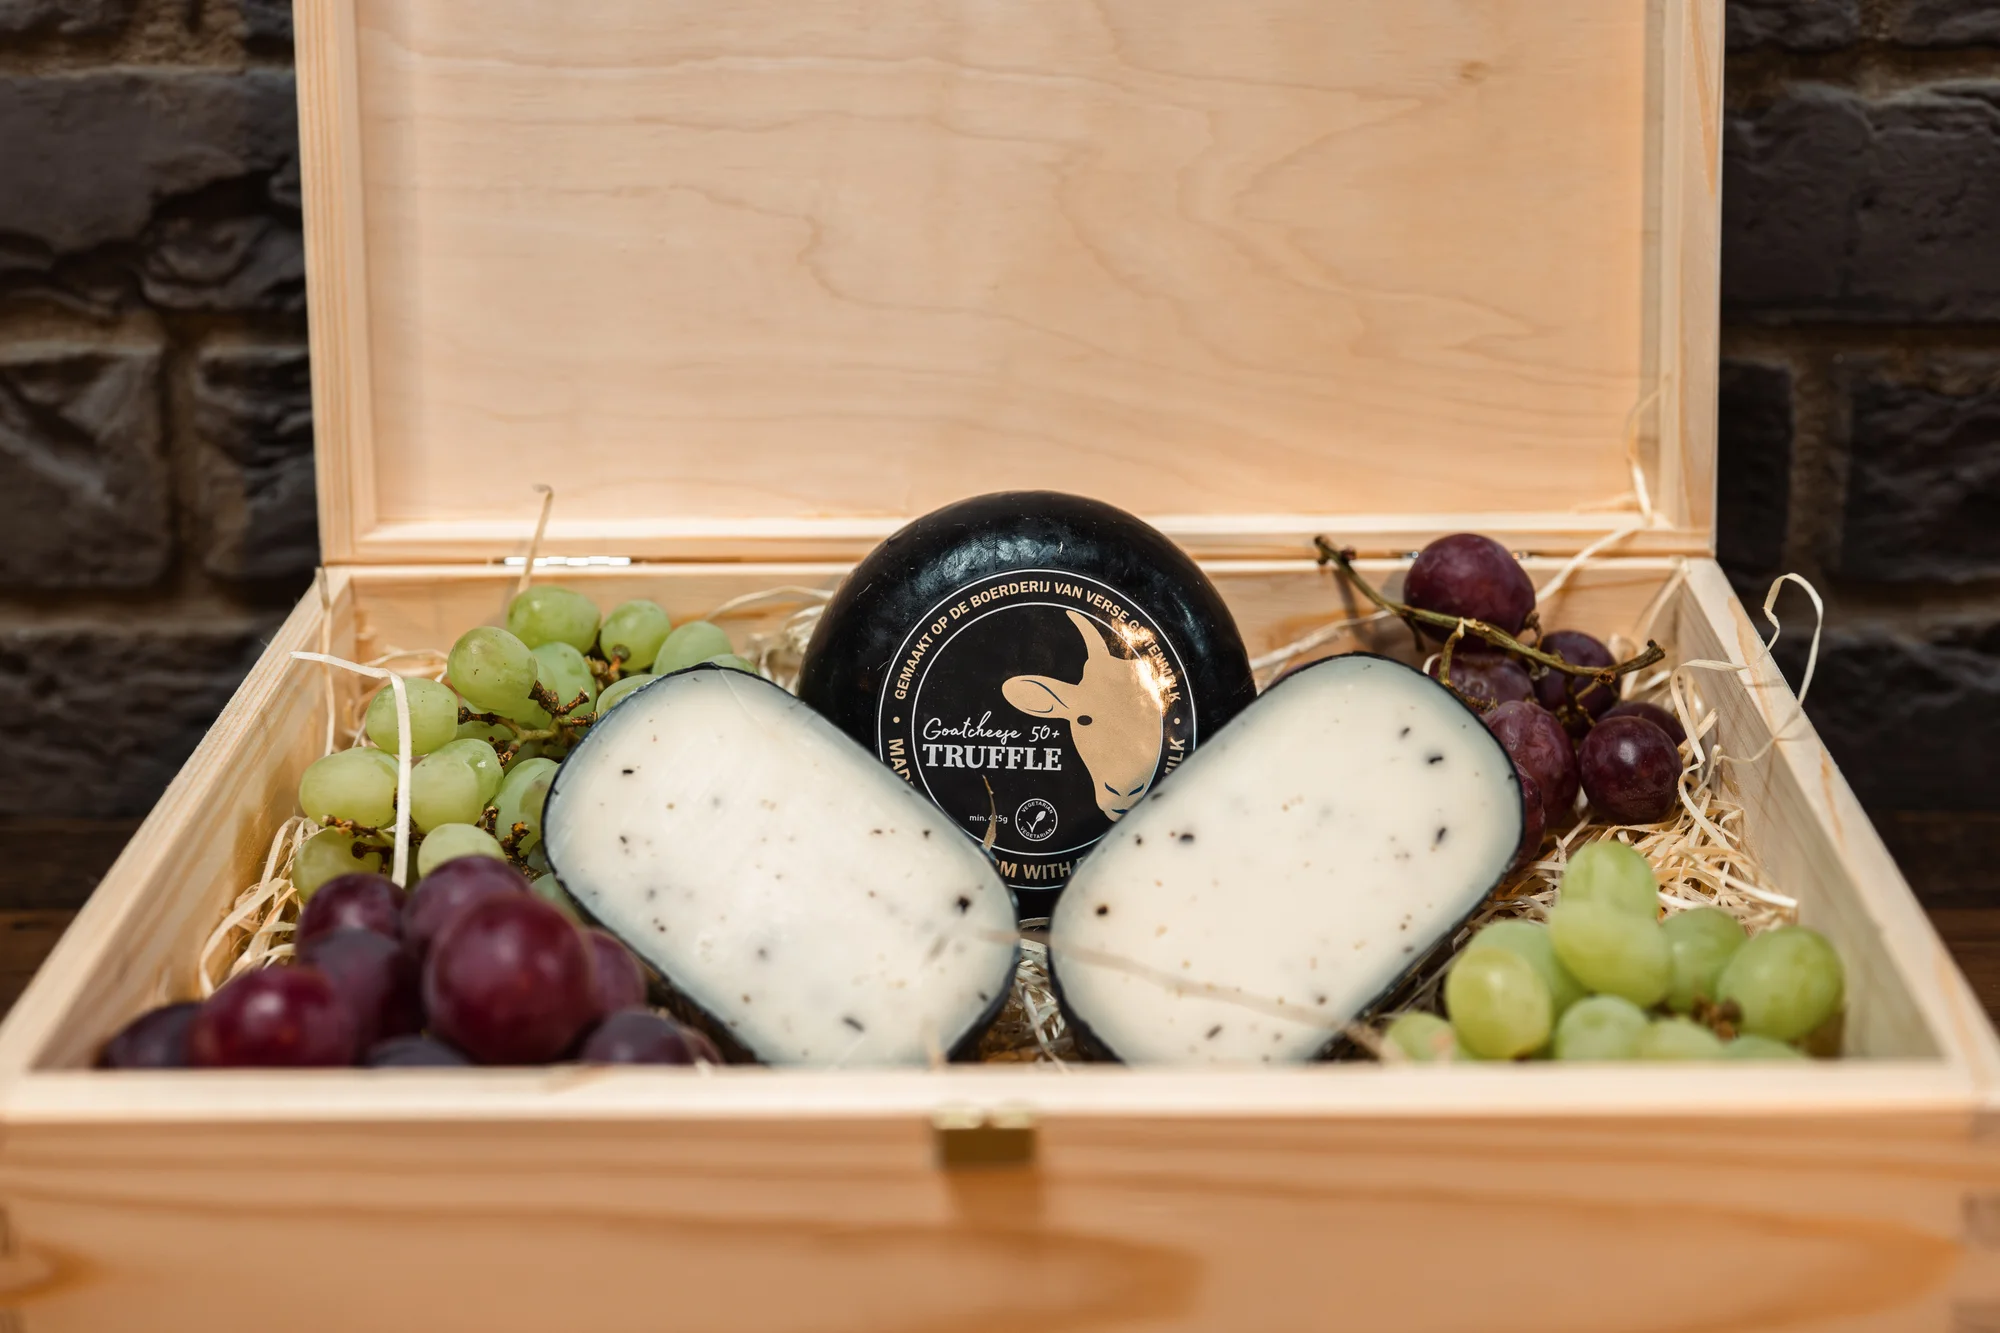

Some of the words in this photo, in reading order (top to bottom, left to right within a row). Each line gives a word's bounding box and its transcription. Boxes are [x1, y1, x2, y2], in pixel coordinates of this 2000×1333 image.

[894, 633, 935, 700] GEMAAKT
[931, 616, 949, 640] OP
[949, 601, 970, 620] DE
[970, 581, 1050, 609] BOERDERIJ
[1054, 582, 1083, 599] VAN
[1086, 591, 1130, 624] VERSE
[1128, 619, 1181, 702] GTENMLK
[923, 711, 1022, 746] Goatcheese
[1028, 726, 1060, 743] 50+
[922, 744, 1062, 771] TRUFFLE
[888, 738, 915, 787] MAD
[1023, 861, 1072, 880] WITH
[969, 814, 986, 822] min.
[1021, 801, 1053, 814] VEGETARIAN
[1020, 826, 1053, 839] VEGETARIAN
